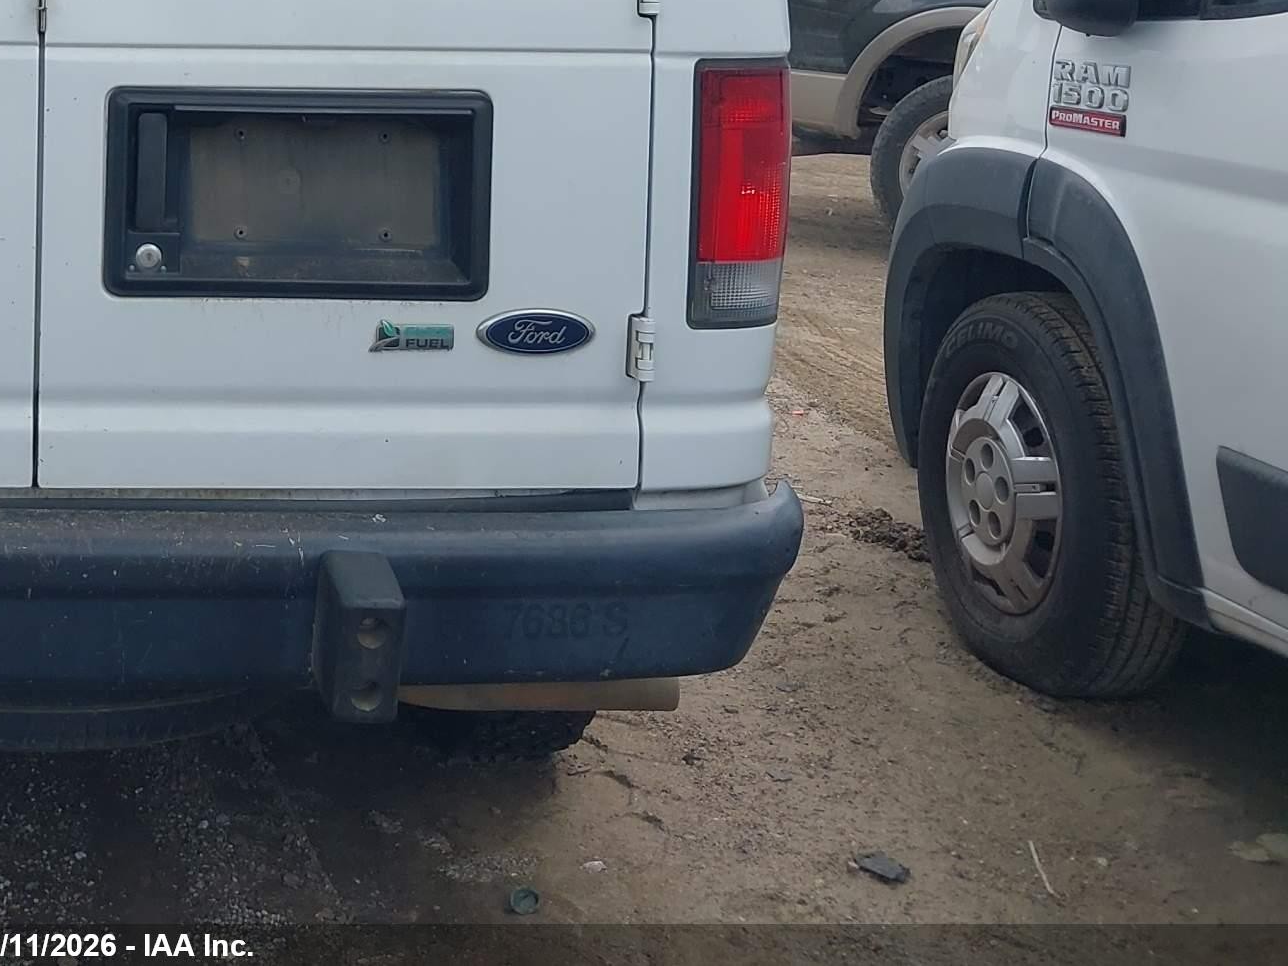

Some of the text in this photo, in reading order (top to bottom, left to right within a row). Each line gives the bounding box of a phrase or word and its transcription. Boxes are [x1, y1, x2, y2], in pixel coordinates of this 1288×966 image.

[1054, 59, 1132, 89] RAM
[1052, 82, 1130, 113] 1500
[405, 338, 450, 349] FUEL
[507, 319, 567, 345] Ford
